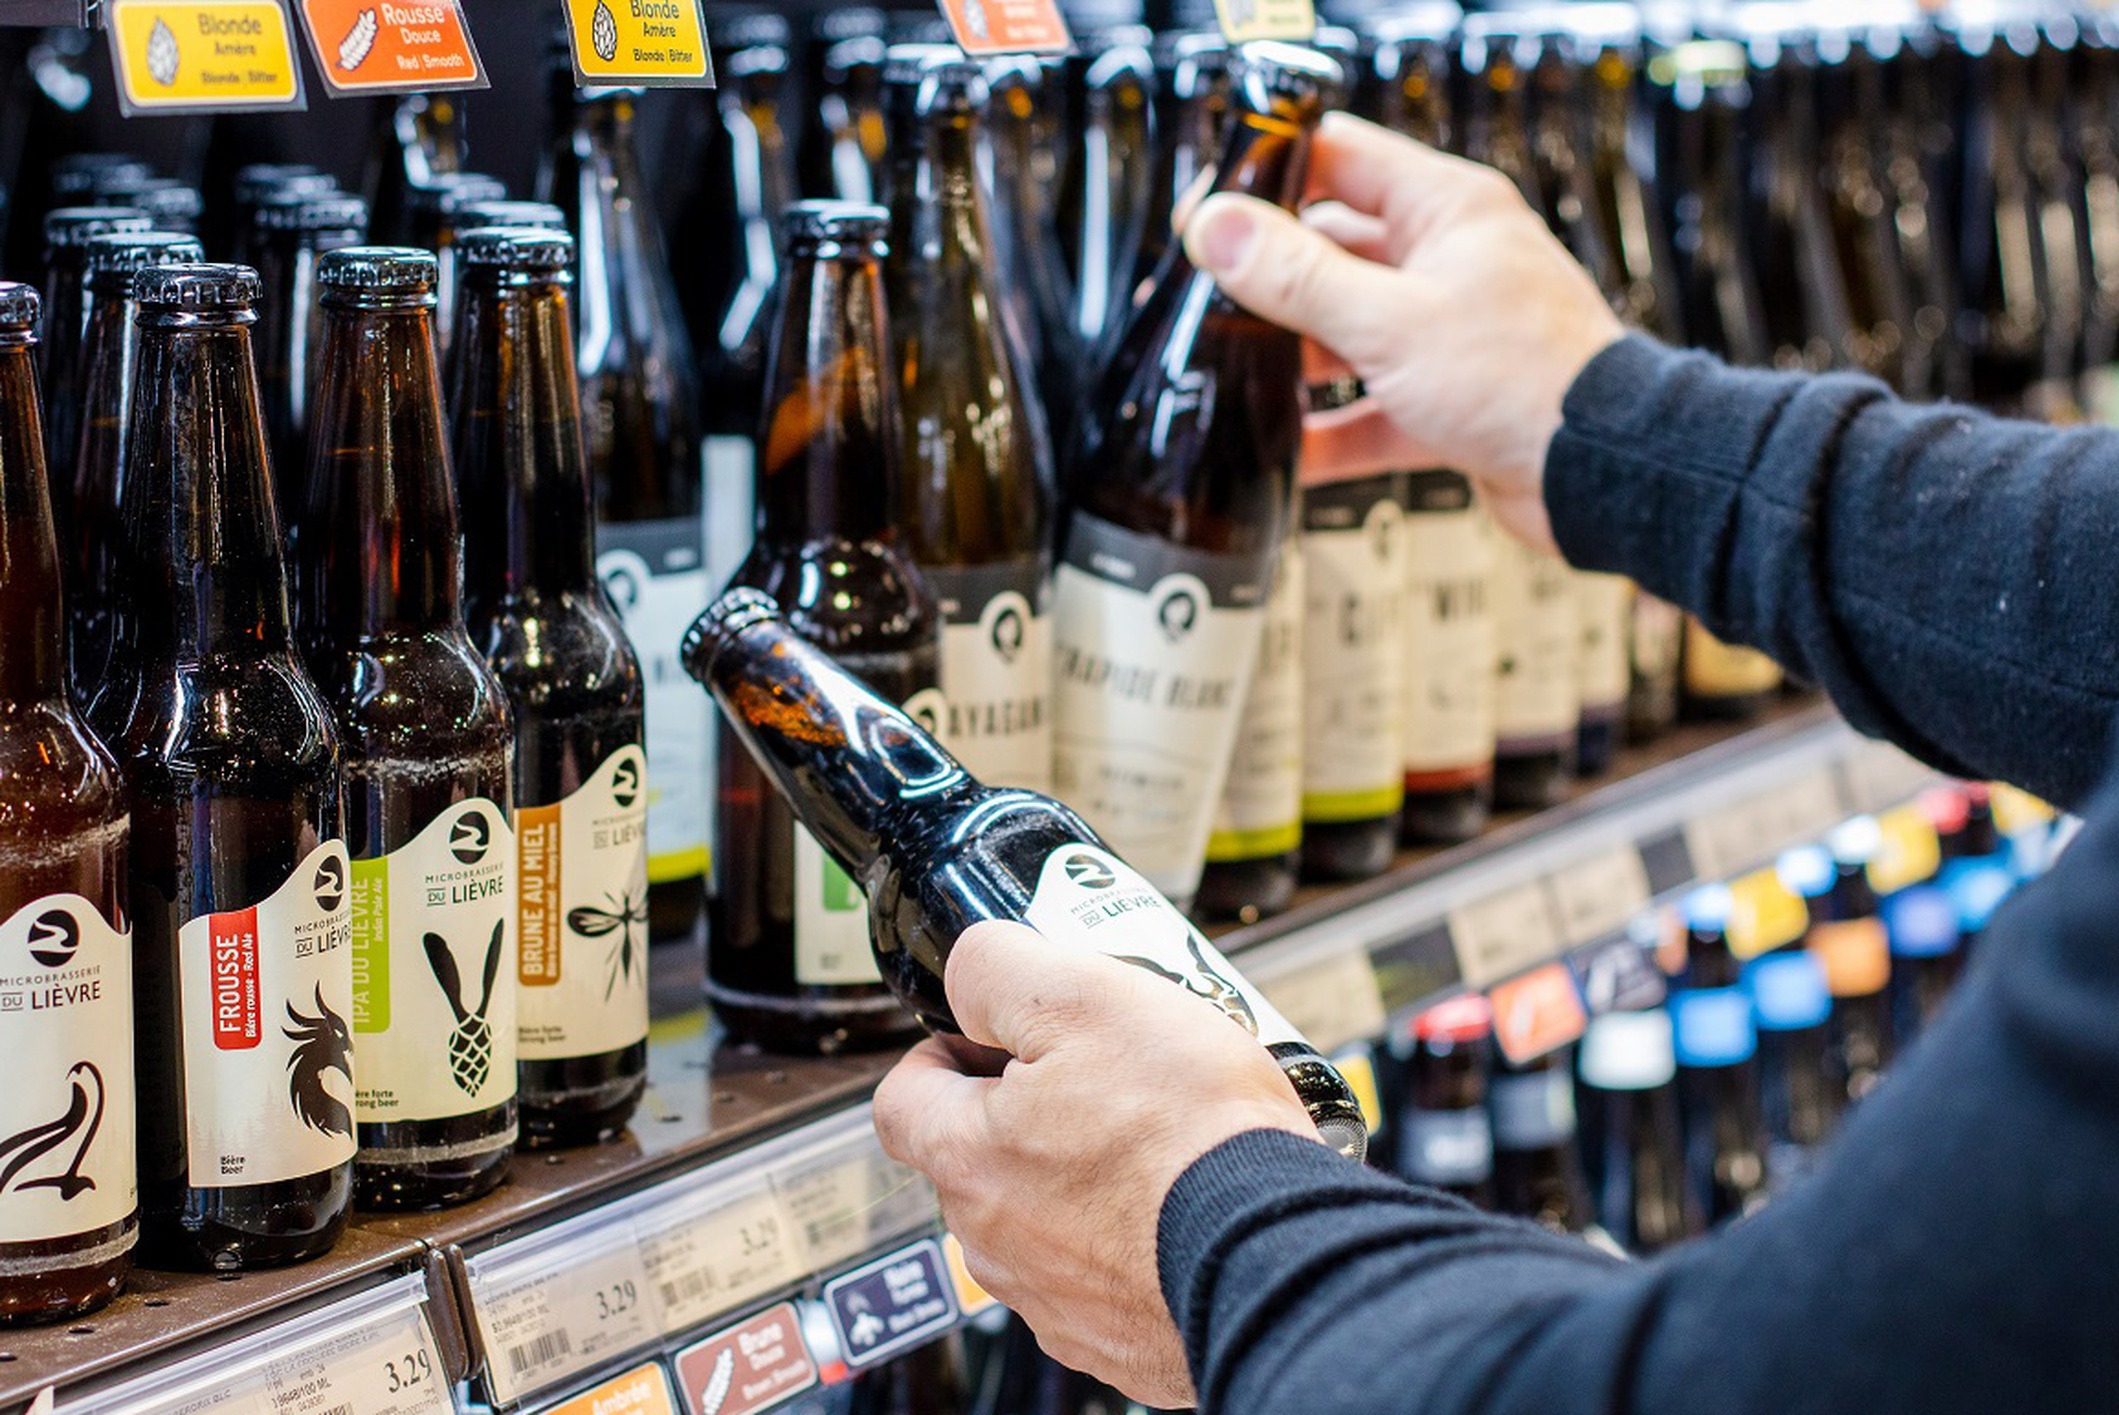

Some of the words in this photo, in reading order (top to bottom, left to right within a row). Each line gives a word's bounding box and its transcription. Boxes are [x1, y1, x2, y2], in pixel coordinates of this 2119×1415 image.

[380, 3, 446, 25] Rousse
[630, 0, 680, 18] Blonde
[197, 13, 262, 35] Blonde
[642, 21, 677, 37] Amère
[400, 27, 442, 44] Douce
[396, 54, 420, 70] Red
[422, 54, 465, 69] Smooth
[633, 48, 665, 62] Blonde
[668, 48, 693, 62] Bitter
[523, 823, 544, 872] MIEL
[427, 891, 446, 903] DU
[452, 875, 504, 904] LIÈVRE
[523, 876, 544, 904] AU
[241, 932, 254, 951] Ale
[296, 942, 313, 954] DU
[522, 909, 544, 977] BRUNE
[243, 951, 254, 972] Red
[0, 964, 101, 986] MICROBRASSERIE
[215, 933, 242, 1033] FROUSSE
[2, 995, 24, 1008] DU
[31, 980, 102, 1010] LIÈVRE
[245, 978, 256, 1010] rousse
[244, 1012, 257, 1039] Bière
[377, 1098, 399, 1107] beer
[220, 1155, 246, 1166] Bière
[221, 1165, 245, 1175] Beer
[596, 1279, 637, 1320] 3.29
[383, 1348, 433, 1394] 3.29
